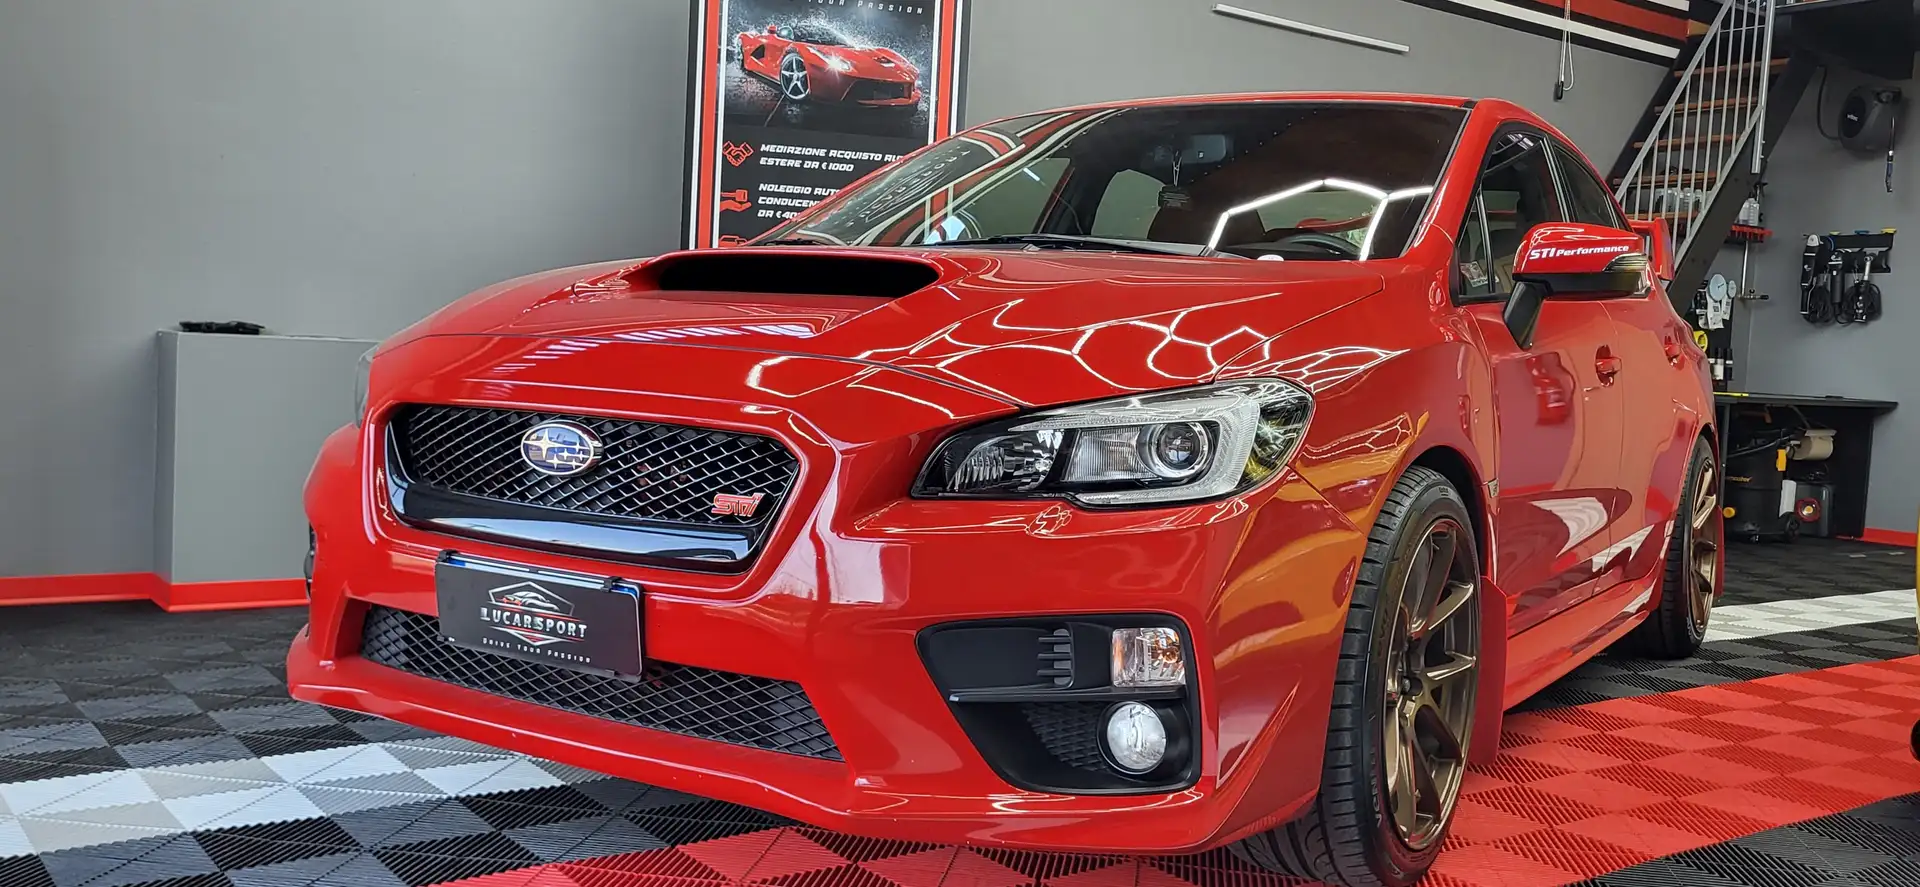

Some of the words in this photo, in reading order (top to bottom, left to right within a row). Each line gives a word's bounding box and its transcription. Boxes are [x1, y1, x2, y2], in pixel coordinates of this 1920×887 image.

[857, 0, 923, 14] PASSION
[760, 144, 827, 157] MEDIAZIONE
[829, 149, 882, 161] ACQUISTO
[884, 154, 904, 162] AU
[759, 157, 802, 168] ESTERE
[803, 160, 819, 170] DA
[758, 183, 812, 195] NOLEGGIO
[757, 196, 821, 208] CONDUCEN
[757, 209, 774, 218] DA
[1529, 247, 1557, 260] STI
[1557, 245, 1629, 257] Performance
[480, 607, 587, 638] LUCARSPORT
[482, 637, 511, 649] DRIVE
[517, 643, 541, 654] YOUR
[547, 649, 591, 663] PASSION
